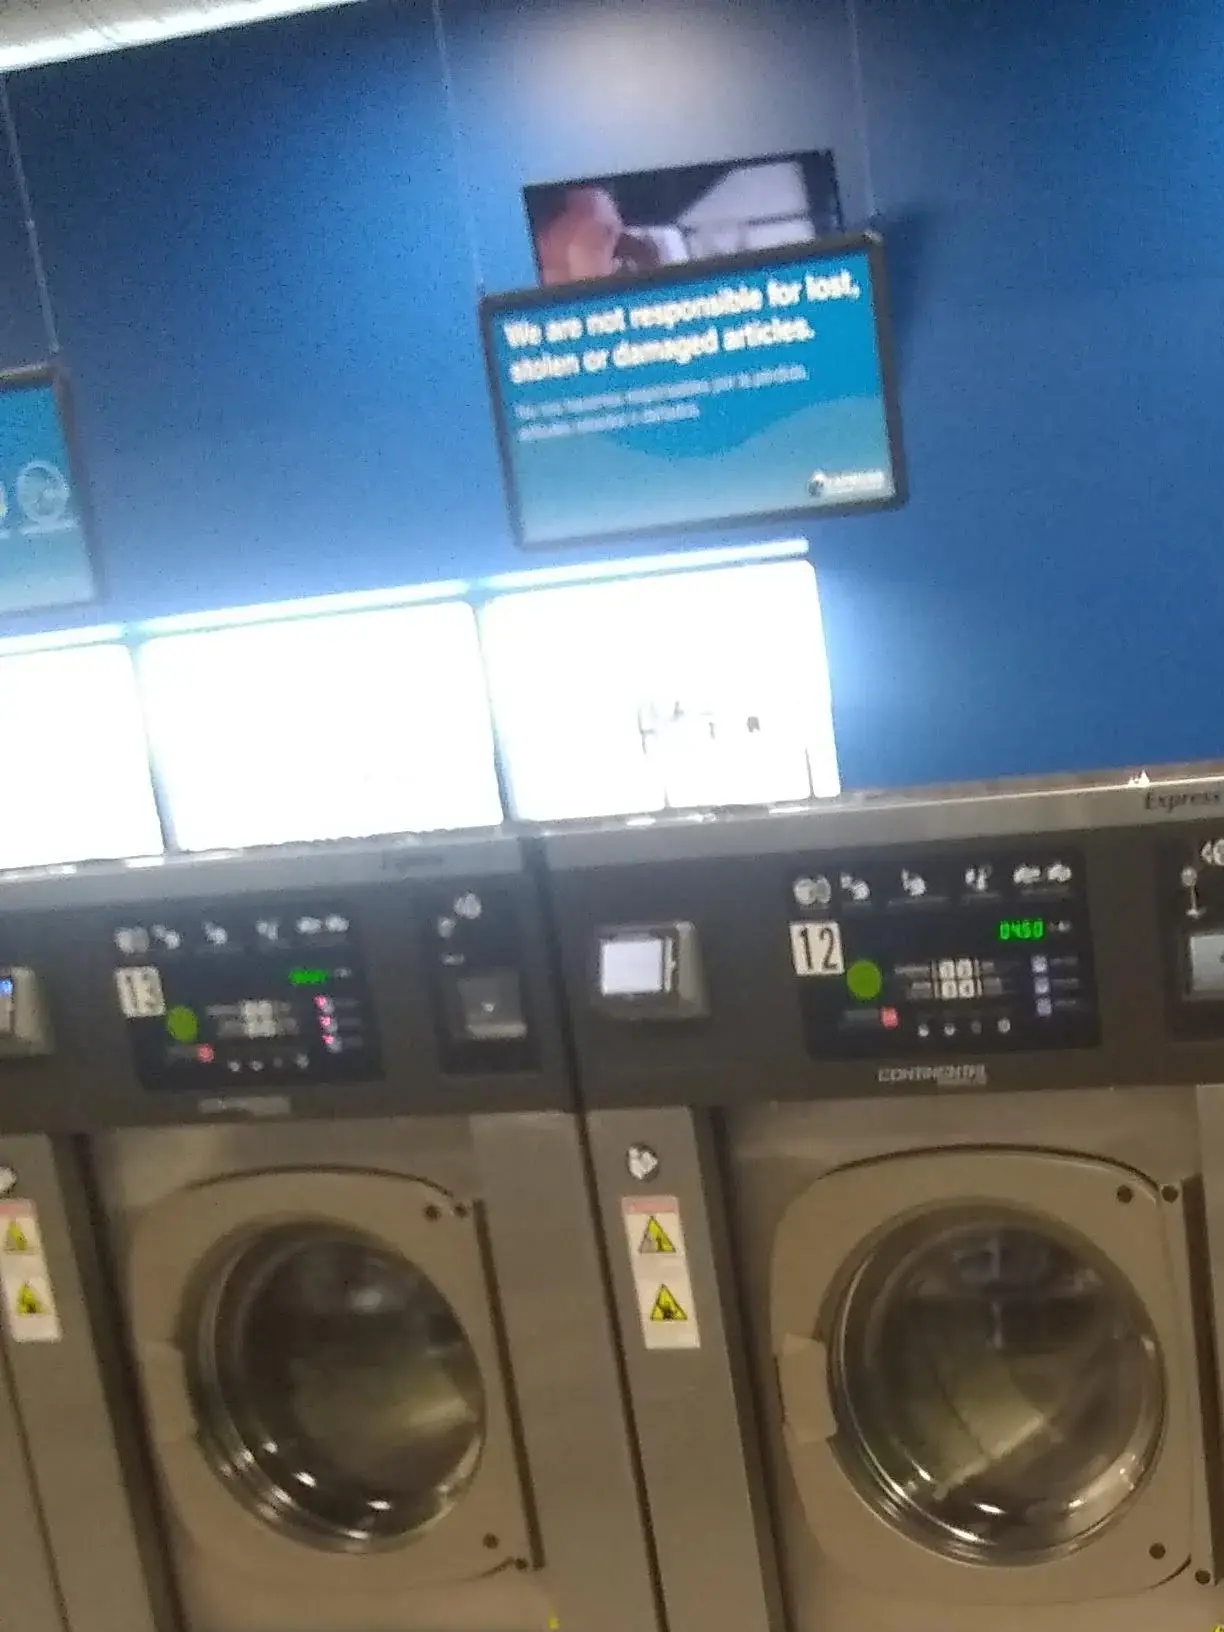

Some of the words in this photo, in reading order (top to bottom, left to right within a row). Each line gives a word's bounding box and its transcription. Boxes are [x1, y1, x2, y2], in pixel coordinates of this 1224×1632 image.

[504, 319, 542, 348] We
[545, 318, 583, 342] are
[586, 308, 626, 336] not
[631, 285, 763, 328] responsible
[766, 279, 802, 308] for
[509, 352, 581, 384] stolen
[582, 350, 608, 372] or
[611, 327, 719, 368] damaged
[799, 926, 839, 972] 12
